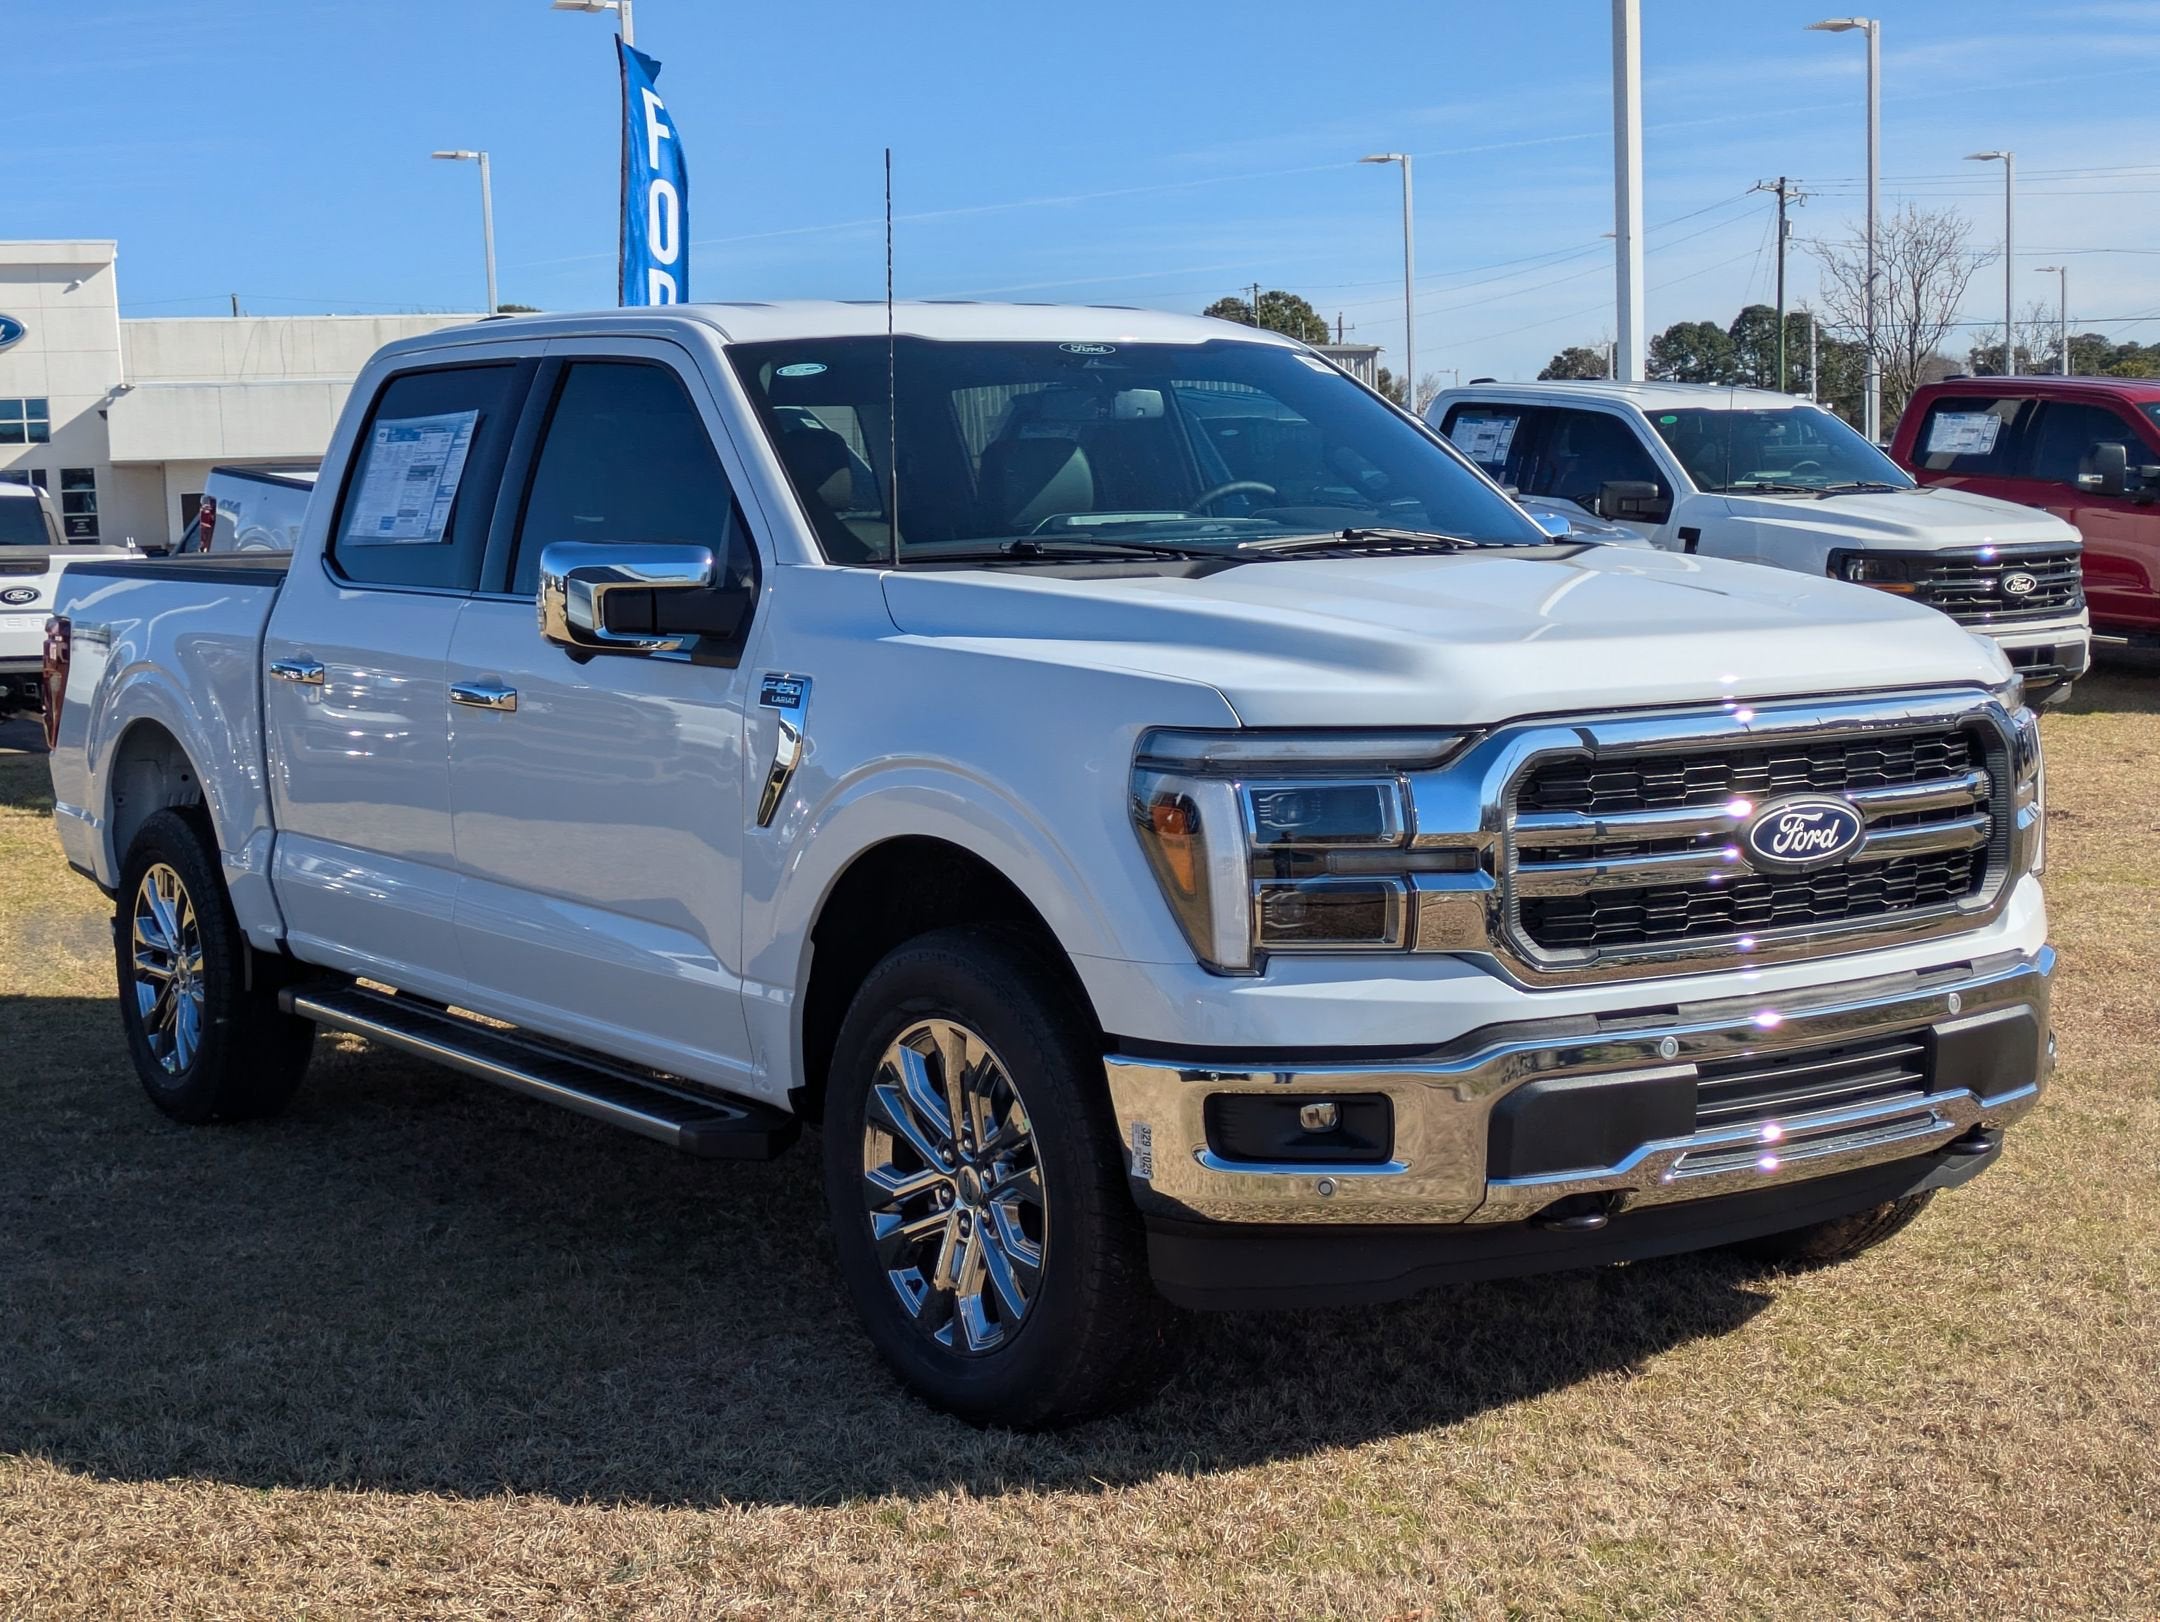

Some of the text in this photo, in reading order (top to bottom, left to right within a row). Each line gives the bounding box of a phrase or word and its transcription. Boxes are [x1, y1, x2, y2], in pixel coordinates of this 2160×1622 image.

[2010, 578, 2032, 591] Ford
[1773, 812, 1840, 854] Ford
[1142, 1127, 1152, 1175] 329 1025
